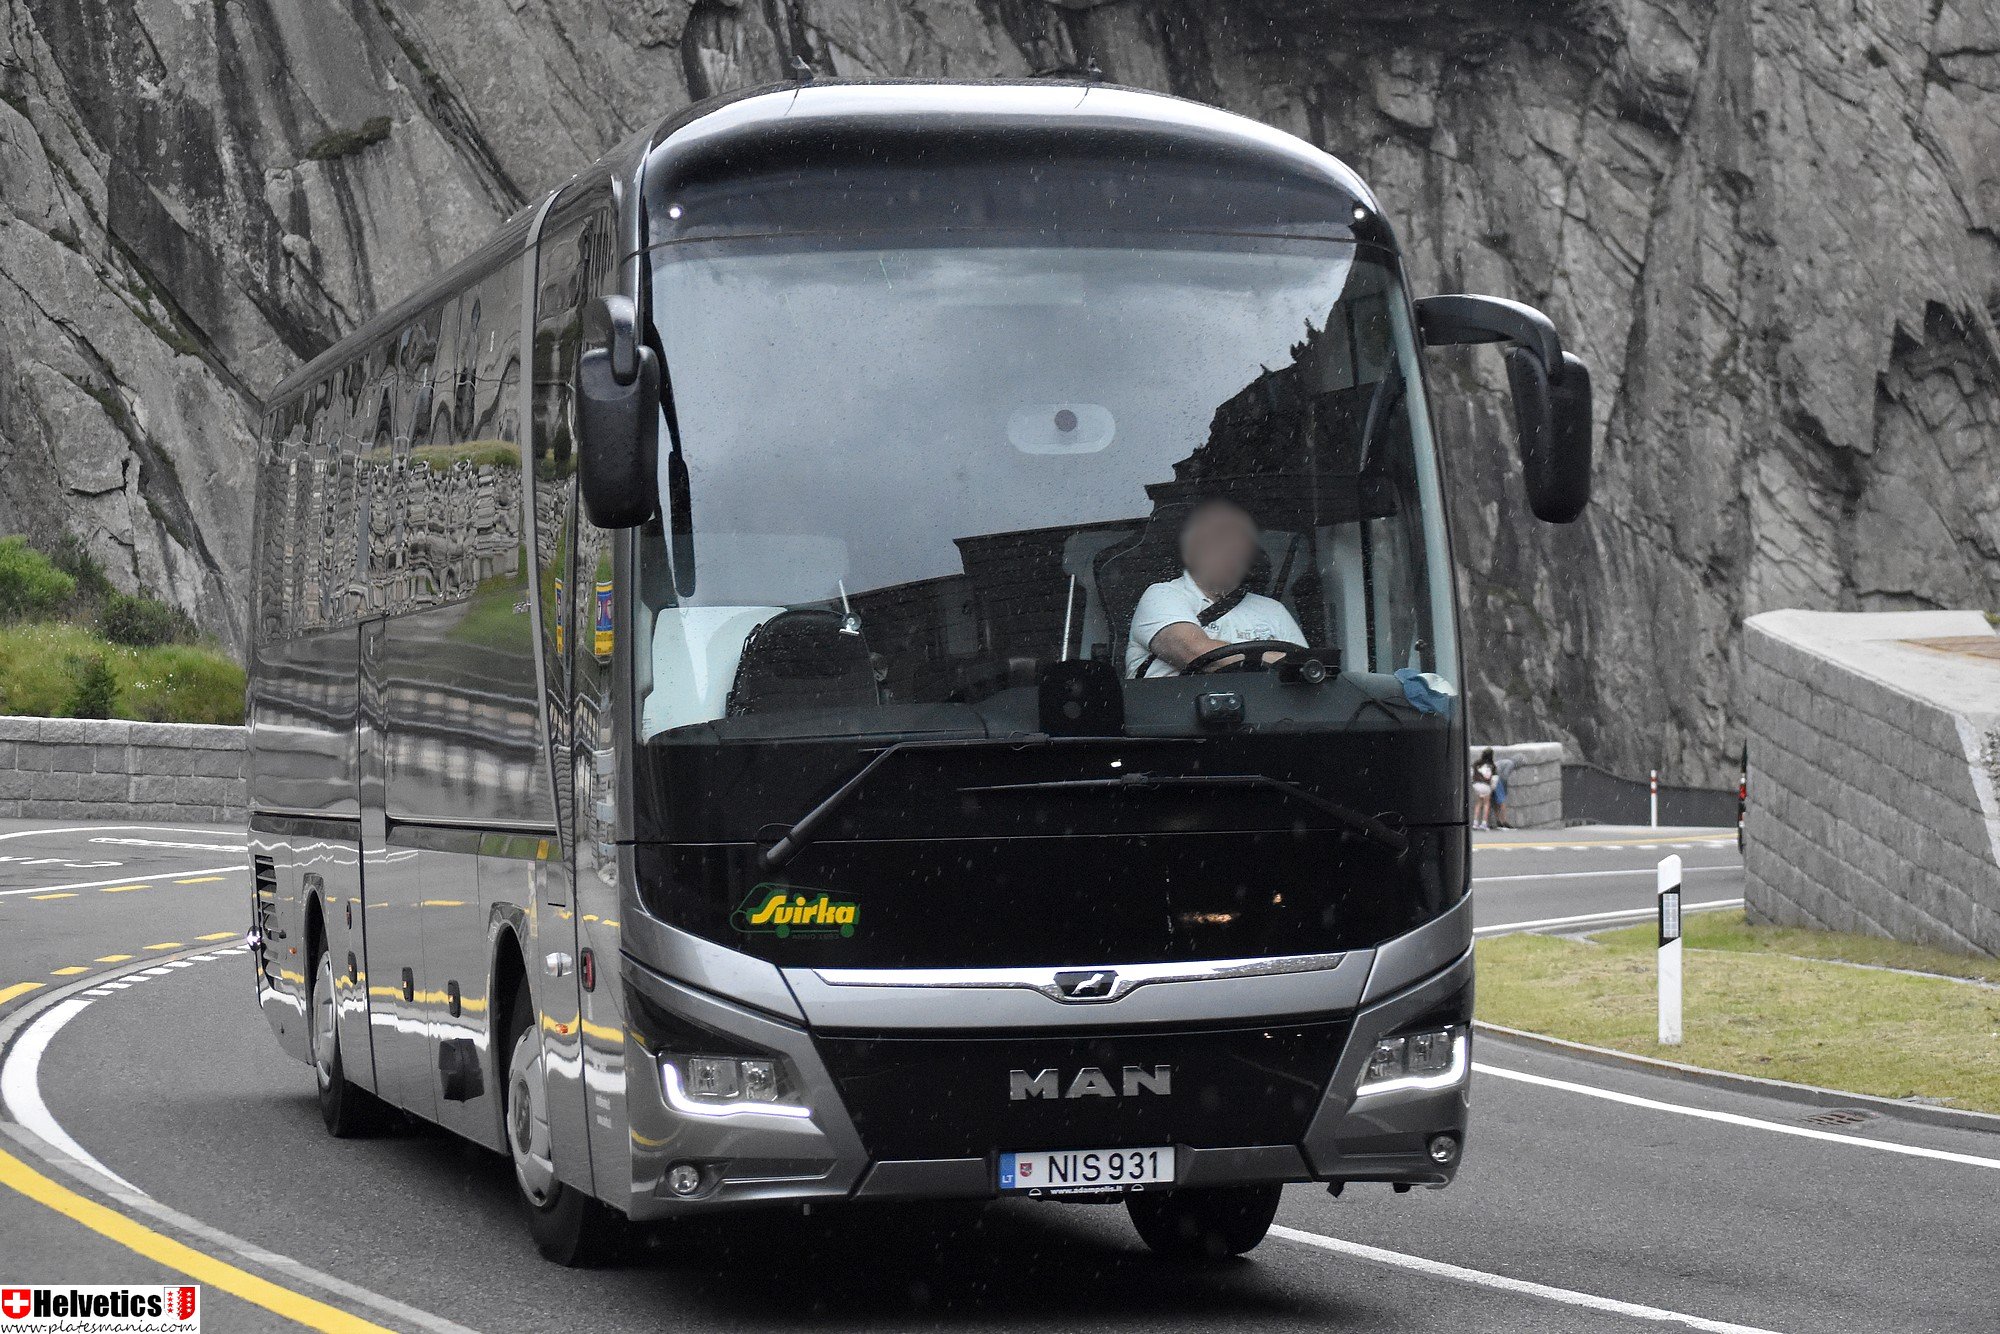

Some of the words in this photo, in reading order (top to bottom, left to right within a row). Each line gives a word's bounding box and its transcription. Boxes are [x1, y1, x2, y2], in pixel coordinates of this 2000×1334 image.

[751, 895, 856, 924] Svirka
[1009, 1065, 1171, 1100] MAN
[1002, 1174, 1013, 1183] LT
